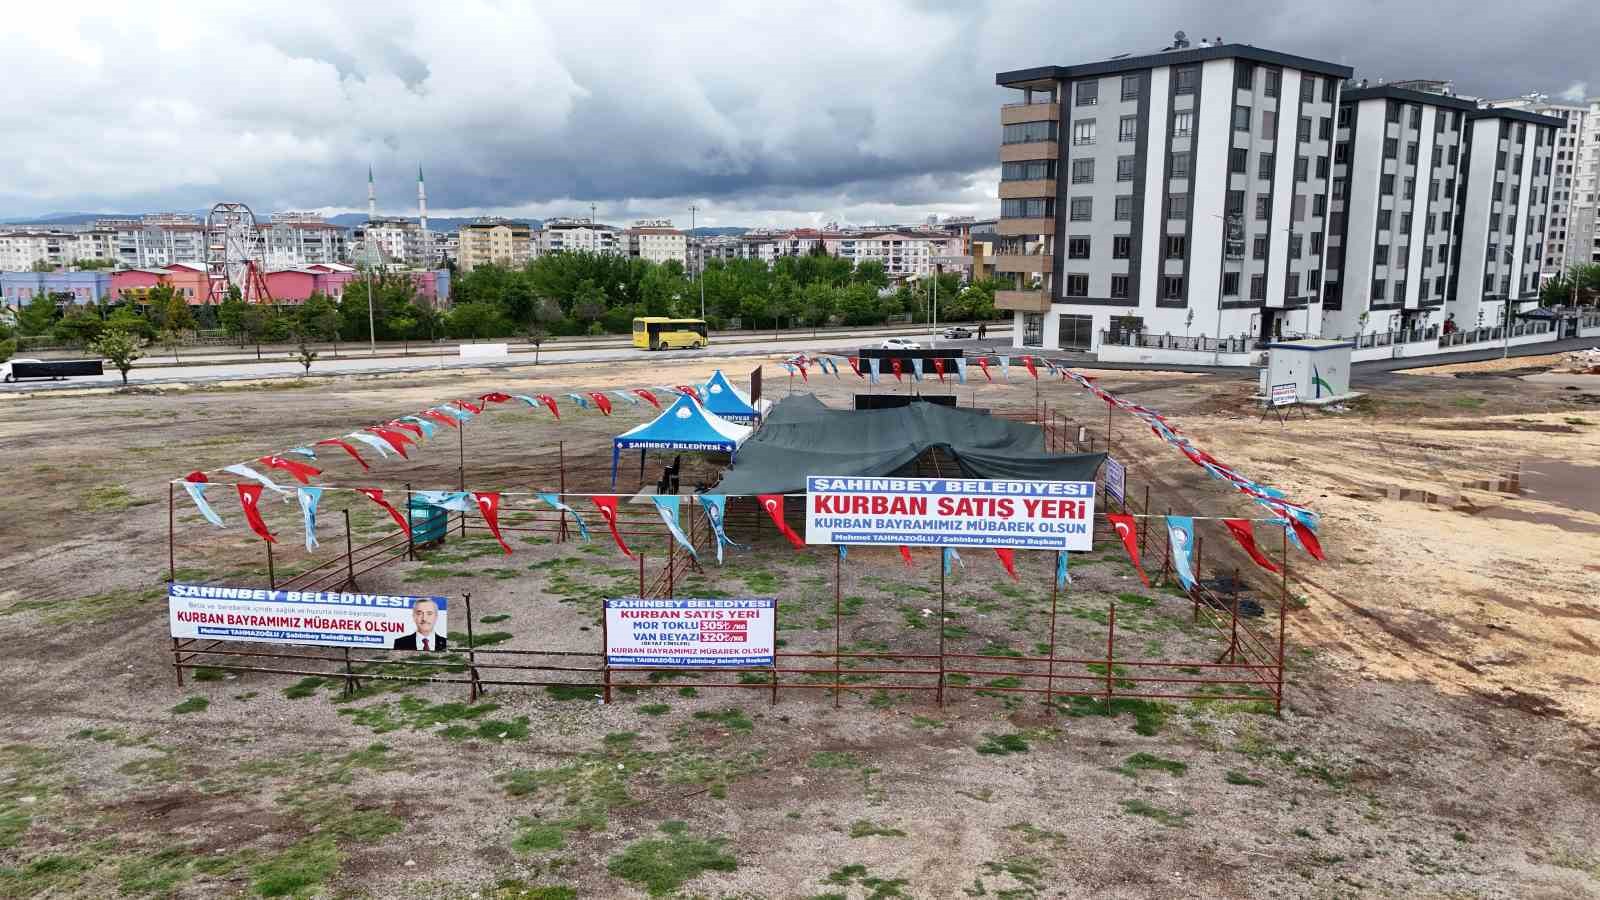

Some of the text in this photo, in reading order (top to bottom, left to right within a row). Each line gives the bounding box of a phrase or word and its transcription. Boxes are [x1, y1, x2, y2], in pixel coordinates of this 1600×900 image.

[673, 442, 720, 451] BELEDİYESİ
[945, 481, 1087, 495] BELEDİYESİ
[814, 495, 1085, 519] KURBAN SATIŞ YERİ
[814, 518, 1086, 534] KURBAN BAYRAMIMIZ MÜBAREK OLSUN
[986, 537, 1026, 545] Belediye
[286, 592, 409, 608] BELEDİYESİ
[687, 600, 770, 608] BELEDİYESİ
[621, 608, 760, 619] KURBAN SATIŞ YERİ
[176, 611, 405, 633] KURBAN BAYRAMIMIZ MÜBAREK OLSUN
[633, 621, 658, 629] MOR
[662, 621, 698, 629] TOKLU
[633, 633, 656, 641] VAN
[659, 633, 699, 641] BEYAZI
[647, 647, 697, 655] BAYRAMIMIZ
[700, 647, 740, 655] MÜBAREK
